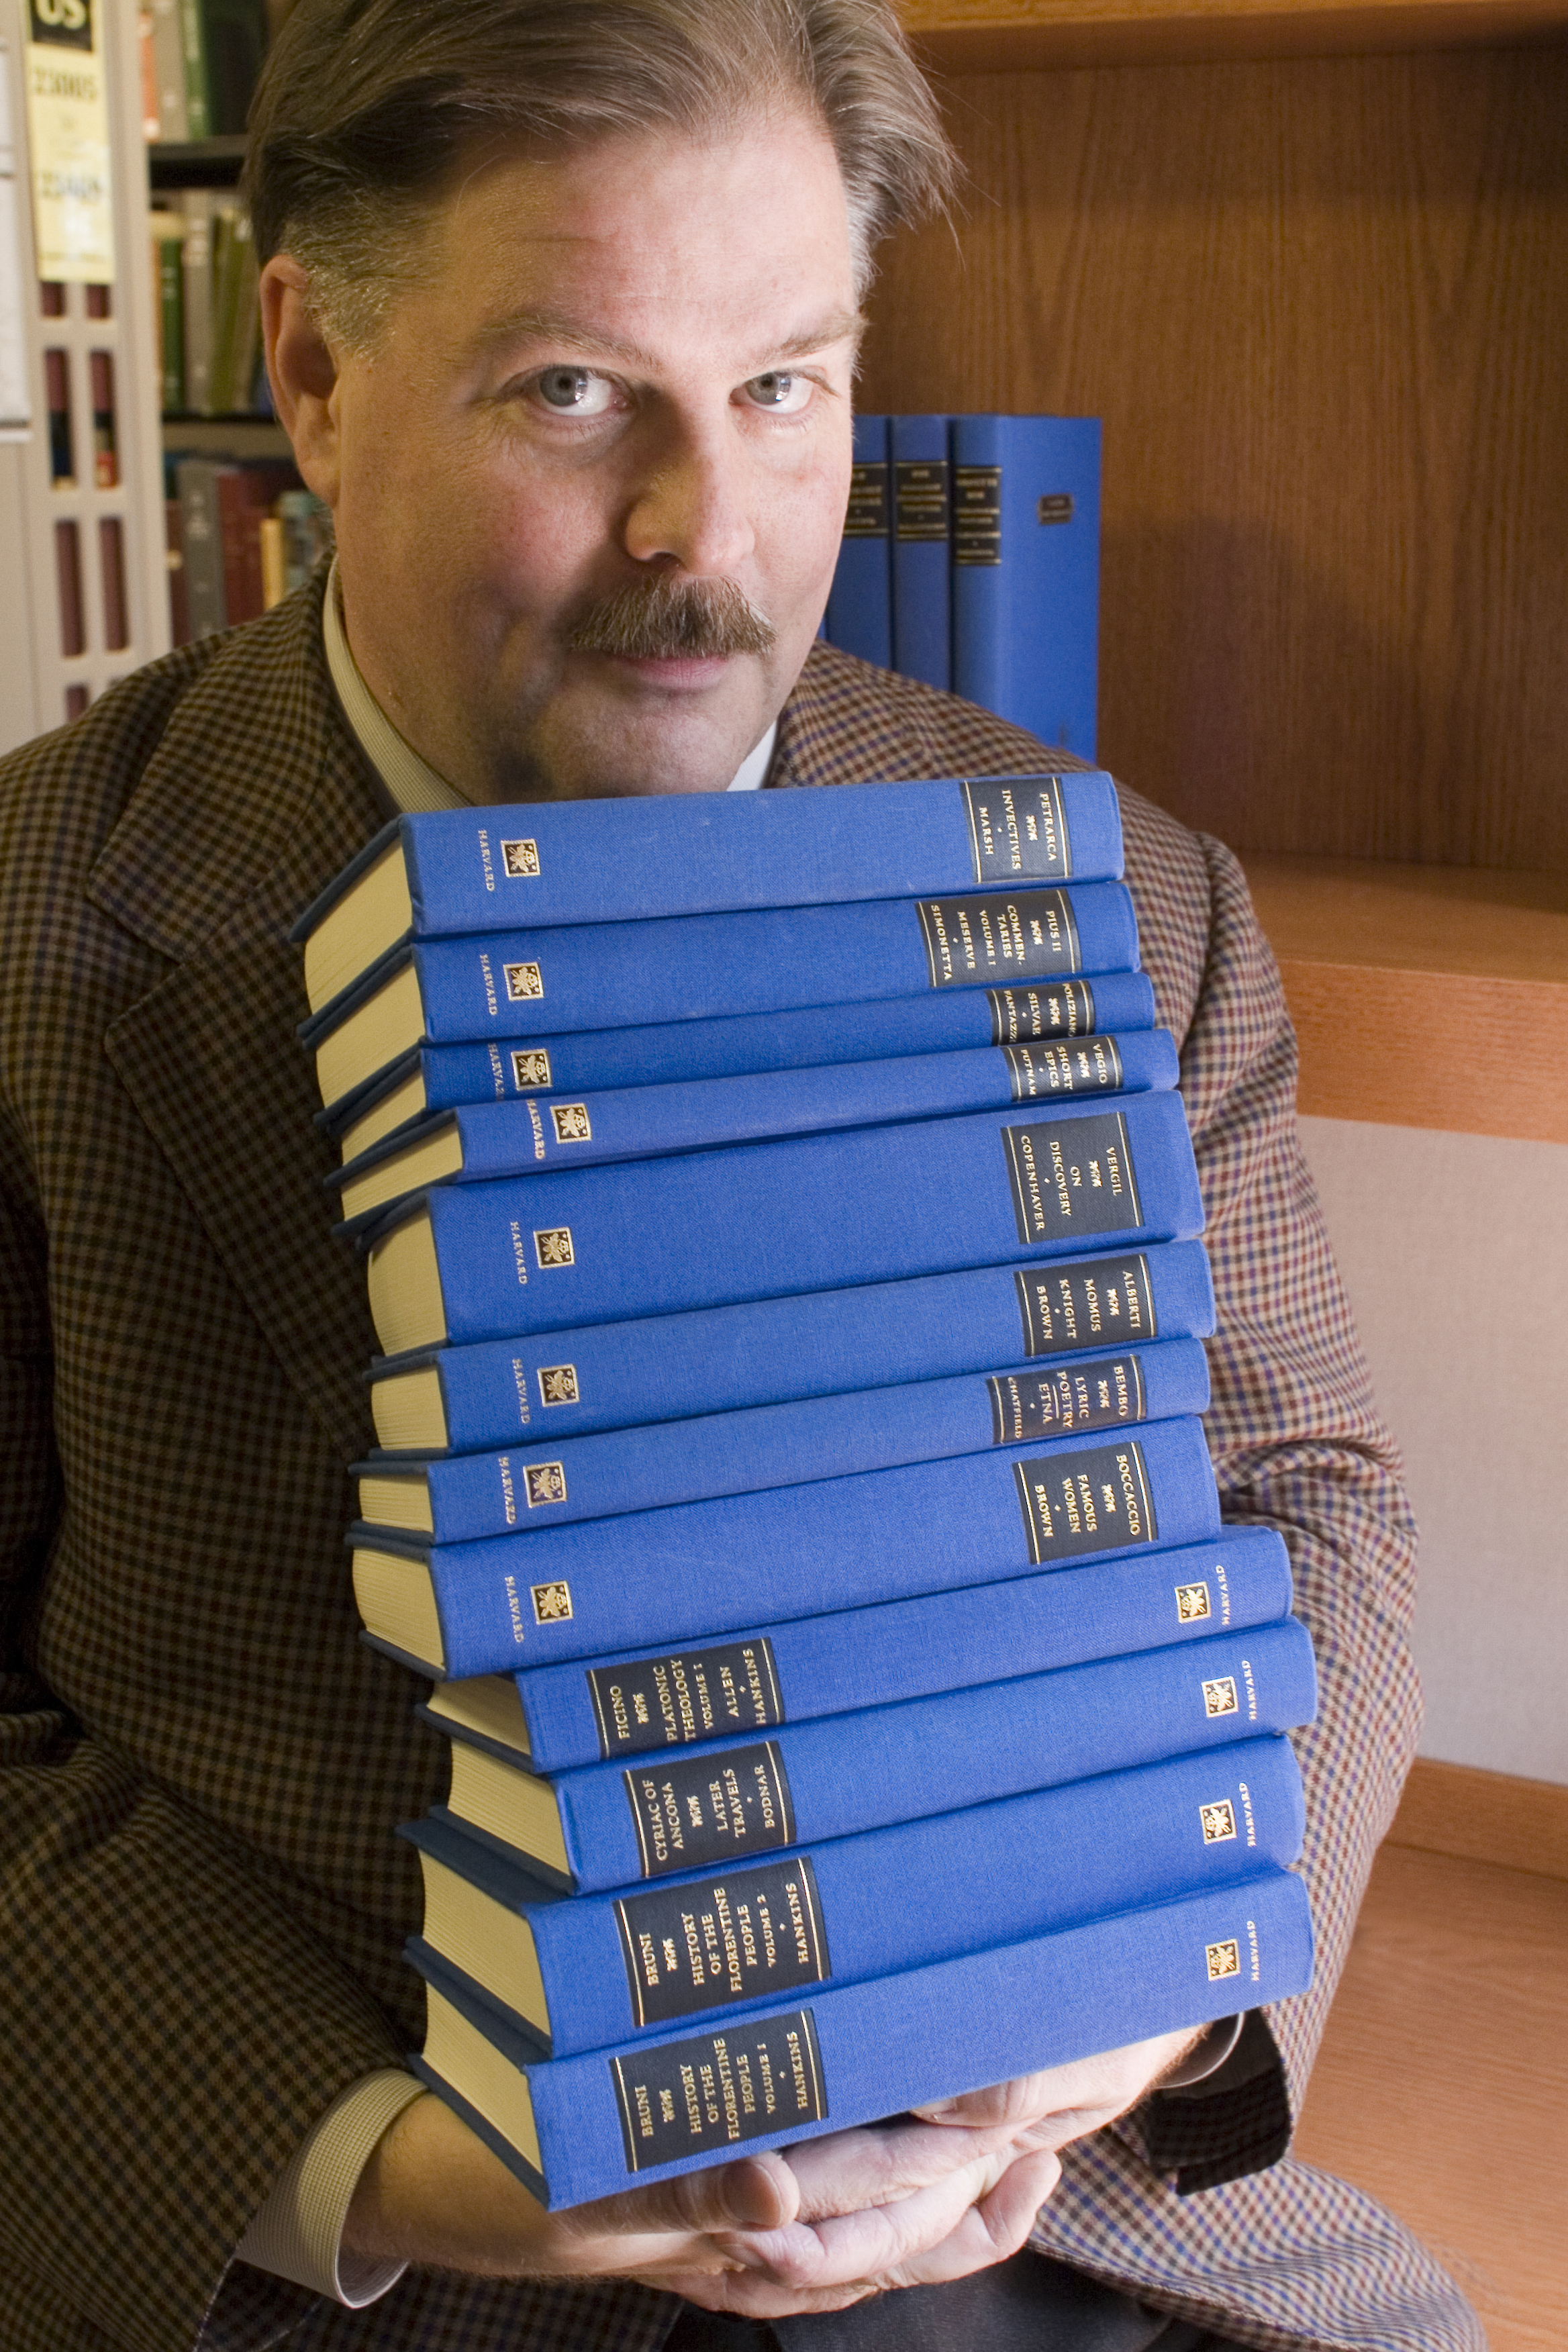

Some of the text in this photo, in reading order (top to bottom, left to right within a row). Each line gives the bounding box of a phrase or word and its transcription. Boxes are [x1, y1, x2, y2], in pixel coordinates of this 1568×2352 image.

[979, 807, 994, 855] MARSH
[1002, 789, 1022, 870] INVECTIVES
[1040, 793, 1057, 861] PETRARCA
[478, 830, 495, 892] HARVARD
[931, 904, 952, 980] SIMONETTA
[957, 911, 976, 969] MESERVE
[979, 910, 995, 957] VOLUME
[997, 914, 1013, 959] TARIES
[1007, 905, 1026, 965] COMMEN-
[1046, 910, 1062, 952] PIUS II
[479, 954, 499, 1016] HARVARD
[1028, 992, 1042, 1035] SILVAE
[1063, 983, 1077, 1037] POLIZIANO
[1021, 1049, 1036, 1095] PUTNAM
[1044, 1050, 1060, 1088] EPICS
[1057, 1046, 1073, 1089] SHORT
[1093, 1044, 1108, 1084] VEGIO
[1021, 1135, 1045, 1231] COPENHAVER
[1050, 1141, 1072, 1216] DISCOVERY
[1070, 1166, 1082, 1187] ON
[1106, 1146, 1122, 1196] VERGIL
[510, 1221, 528, 1285] HARVARD
[1036, 1285, 1052, 1340] BROWN
[1059, 1279, 1077, 1339] KNIGHT
[1084, 1279, 1101, 1332] MOMUS
[1122, 1271, 1141, 1328] ALBERTI
[512, 1358, 530, 1424] HARVARD
[1008, 1377, 1023, 1438] CHATFIELD
[1039, 1383, 1053, 1424] ETNA
[1057, 1371, 1073, 1428] POETRY
[1075, 1377, 1089, 1418] LYRIC
[1114, 1365, 1128, 1417] BEMBO
[498, 1457, 517, 1524] HARVARD
[1034, 1484, 1054, 1537] BROWN
[1062, 1477, 1081, 1534] WOMEN
[1077, 1474, 1097, 1532] FAMOUS
[1116, 1454, 1140, 1536] BOCCACCIO
[504, 1575, 524, 1643] HARVARD
[1216, 1564, 1231, 1625] HARVARD
[609, 1685, 630, 1740] FICINO
[653, 1665, 678, 1742] PLATONIC
[671, 1659, 697, 1741] THEOLOGY
[696, 1673, 714, 1730] VOLUME
[720, 1666, 739, 1718] ALLEN
[742, 1649, 767, 1725] HANKINS
[1242, 1660, 1257, 1720] HARVARD
[642, 1779, 669, 1862] CYRIAC OF
[662, 1781, 684, 1850] ANCONA
[709, 1780, 728, 1832] LATER
[722, 1768, 746, 1839] TRAVELS
[754, 1764, 775, 1828] BODNAR
[1239, 1782, 1257, 1847] HARVARD
[681, 1912, 705, 1986] HISTORY
[701, 1914, 722, 1975] OF THE
[714, 1887, 742, 1992] FLORENTINE
[737, 1904, 758, 1967] PEOPLE
[756, 1894, 776, 1967] VOLUME 2
[785, 1882, 809, 1964] HANKINS
[1246, 1920, 1260, 1981] HARVARD
[639, 1933, 659, 1986] BRUNI
[680, 2064, 702, 2134] HISTORY
[699, 2063, 719, 2124] OF THE
[713, 2038, 740, 2140] FLORENTINE
[736, 2054, 756, 2114] PEOPLE
[758, 2053, 776, 2114] VOLUME
[786, 2031, 808, 2109] HANKINS
[635, 2085, 654, 2137] BRUNI
